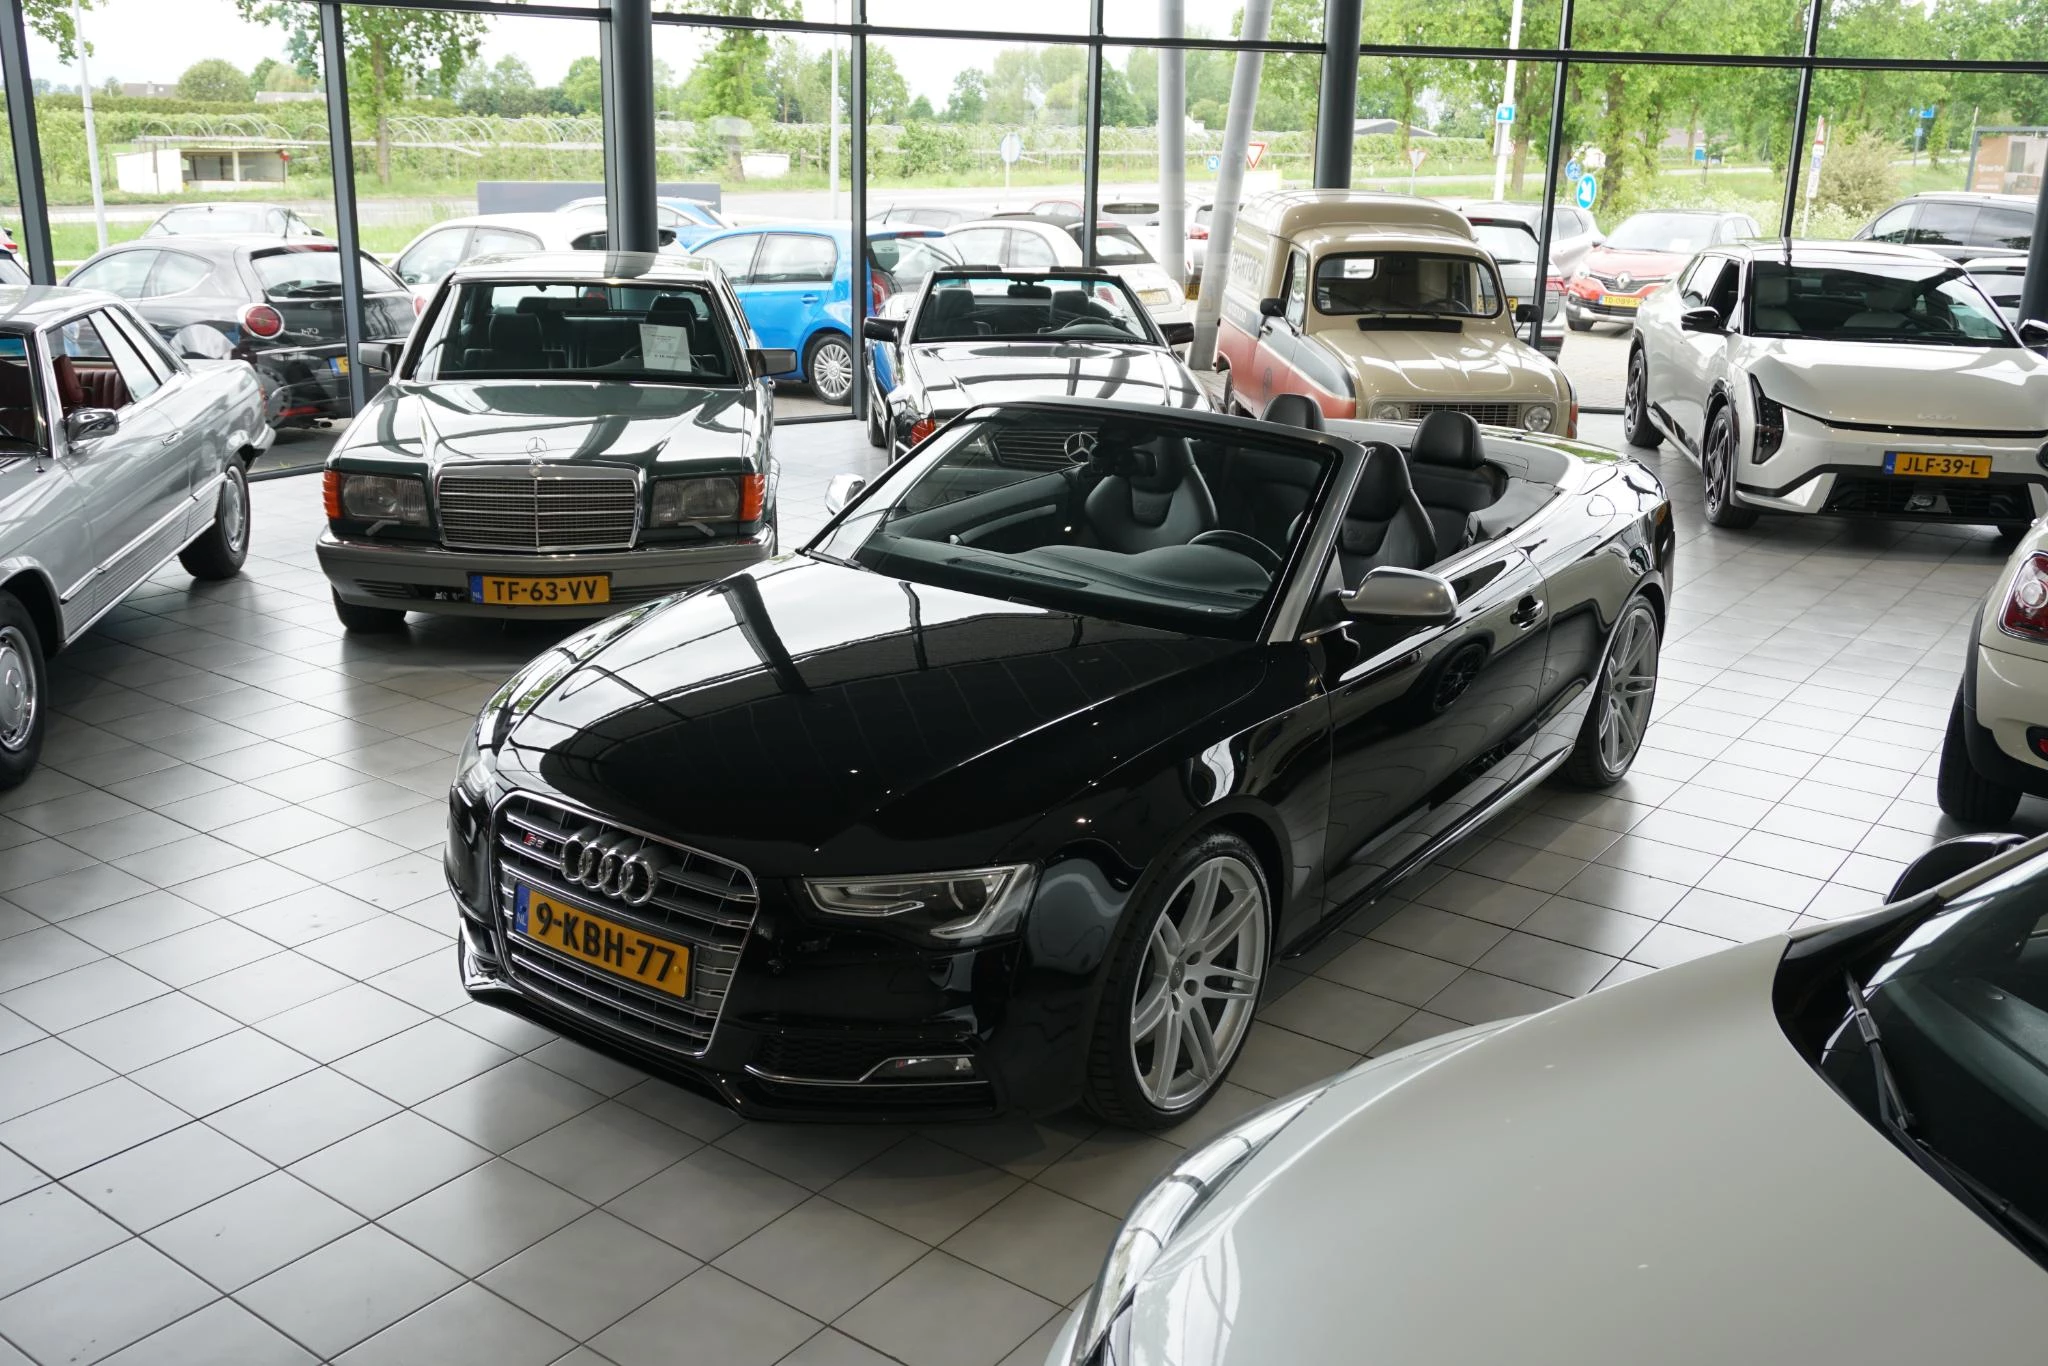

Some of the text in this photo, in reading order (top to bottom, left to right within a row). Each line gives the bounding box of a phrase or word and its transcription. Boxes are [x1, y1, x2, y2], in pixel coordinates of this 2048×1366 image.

[1902, 457, 1980, 475] JLF-39-L
[492, 580, 598, 601] TF-63-VV
[516, 901, 677, 983] NL 9-KBH-77
